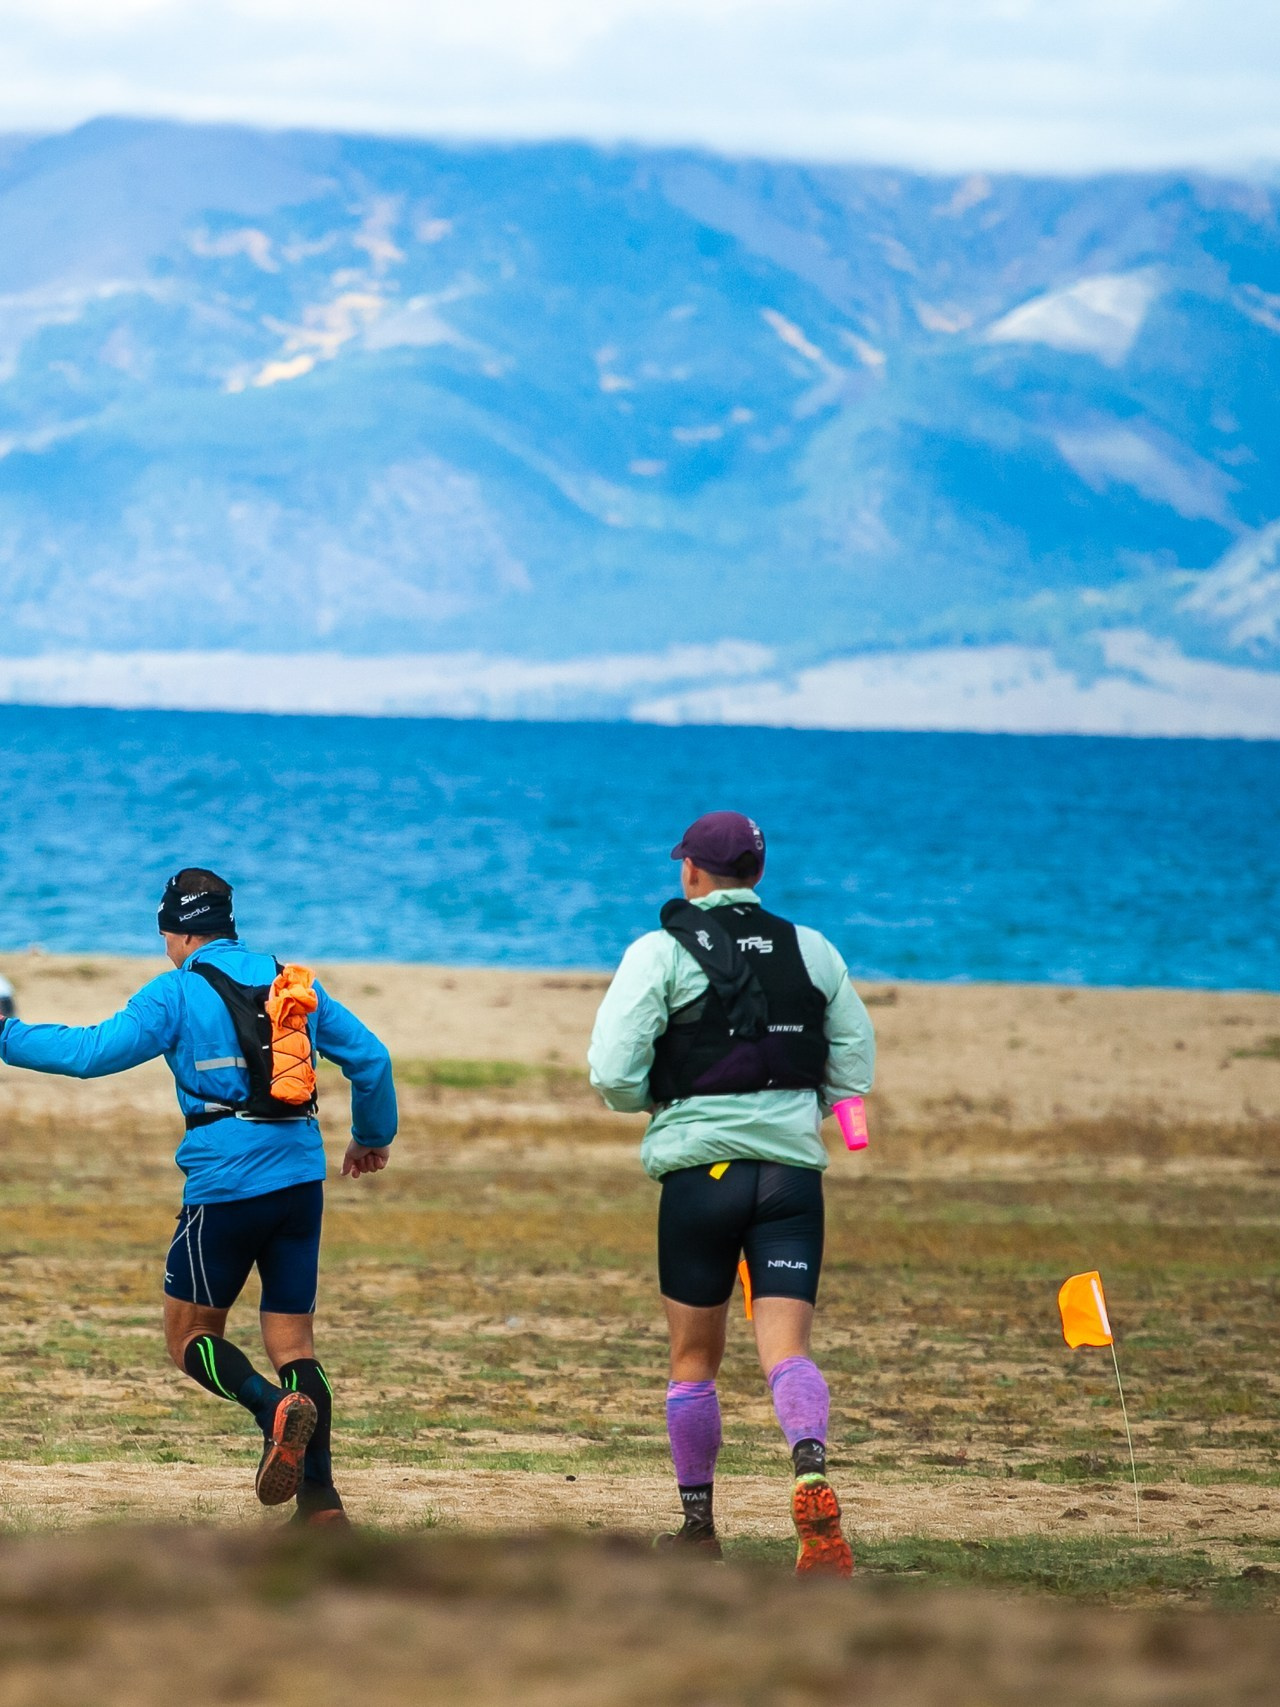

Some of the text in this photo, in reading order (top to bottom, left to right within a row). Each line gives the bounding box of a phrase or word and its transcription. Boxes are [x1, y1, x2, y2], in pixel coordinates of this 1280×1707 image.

[736, 936, 773, 954] TRS
[767, 1024, 804, 1033] UNNING
[767, 1259, 808, 1271] NINJA
